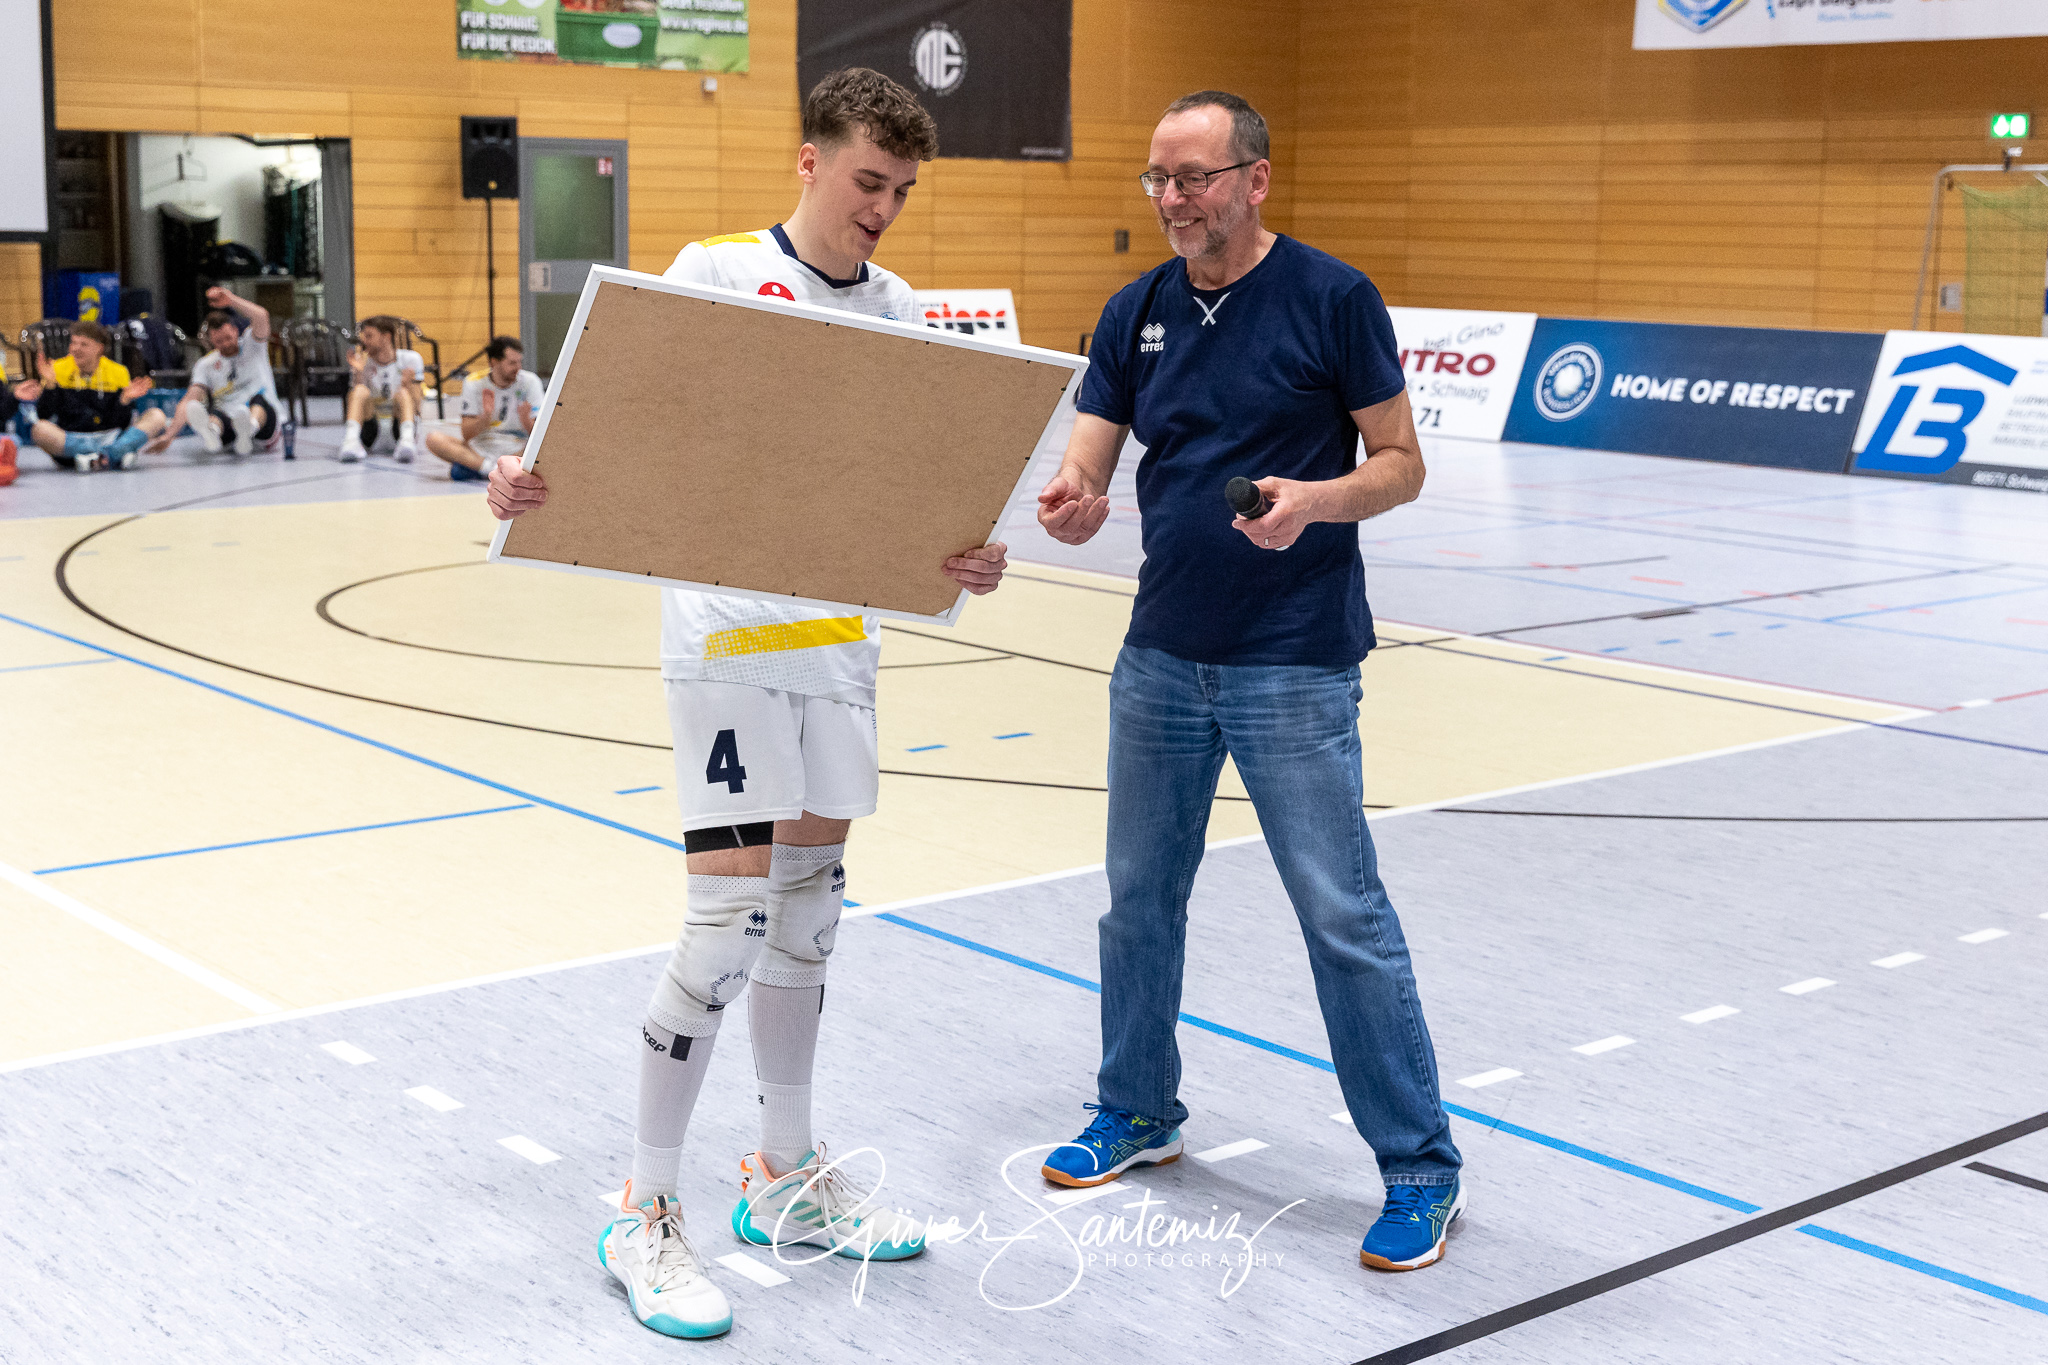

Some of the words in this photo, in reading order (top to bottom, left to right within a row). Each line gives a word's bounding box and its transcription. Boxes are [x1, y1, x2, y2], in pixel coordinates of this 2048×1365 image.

[1610, 374, 1688, 402] HOME
[1690, 379, 1729, 404] OF
[1729, 381, 1855, 414] RESPECT
[706, 729, 747, 794] 4
